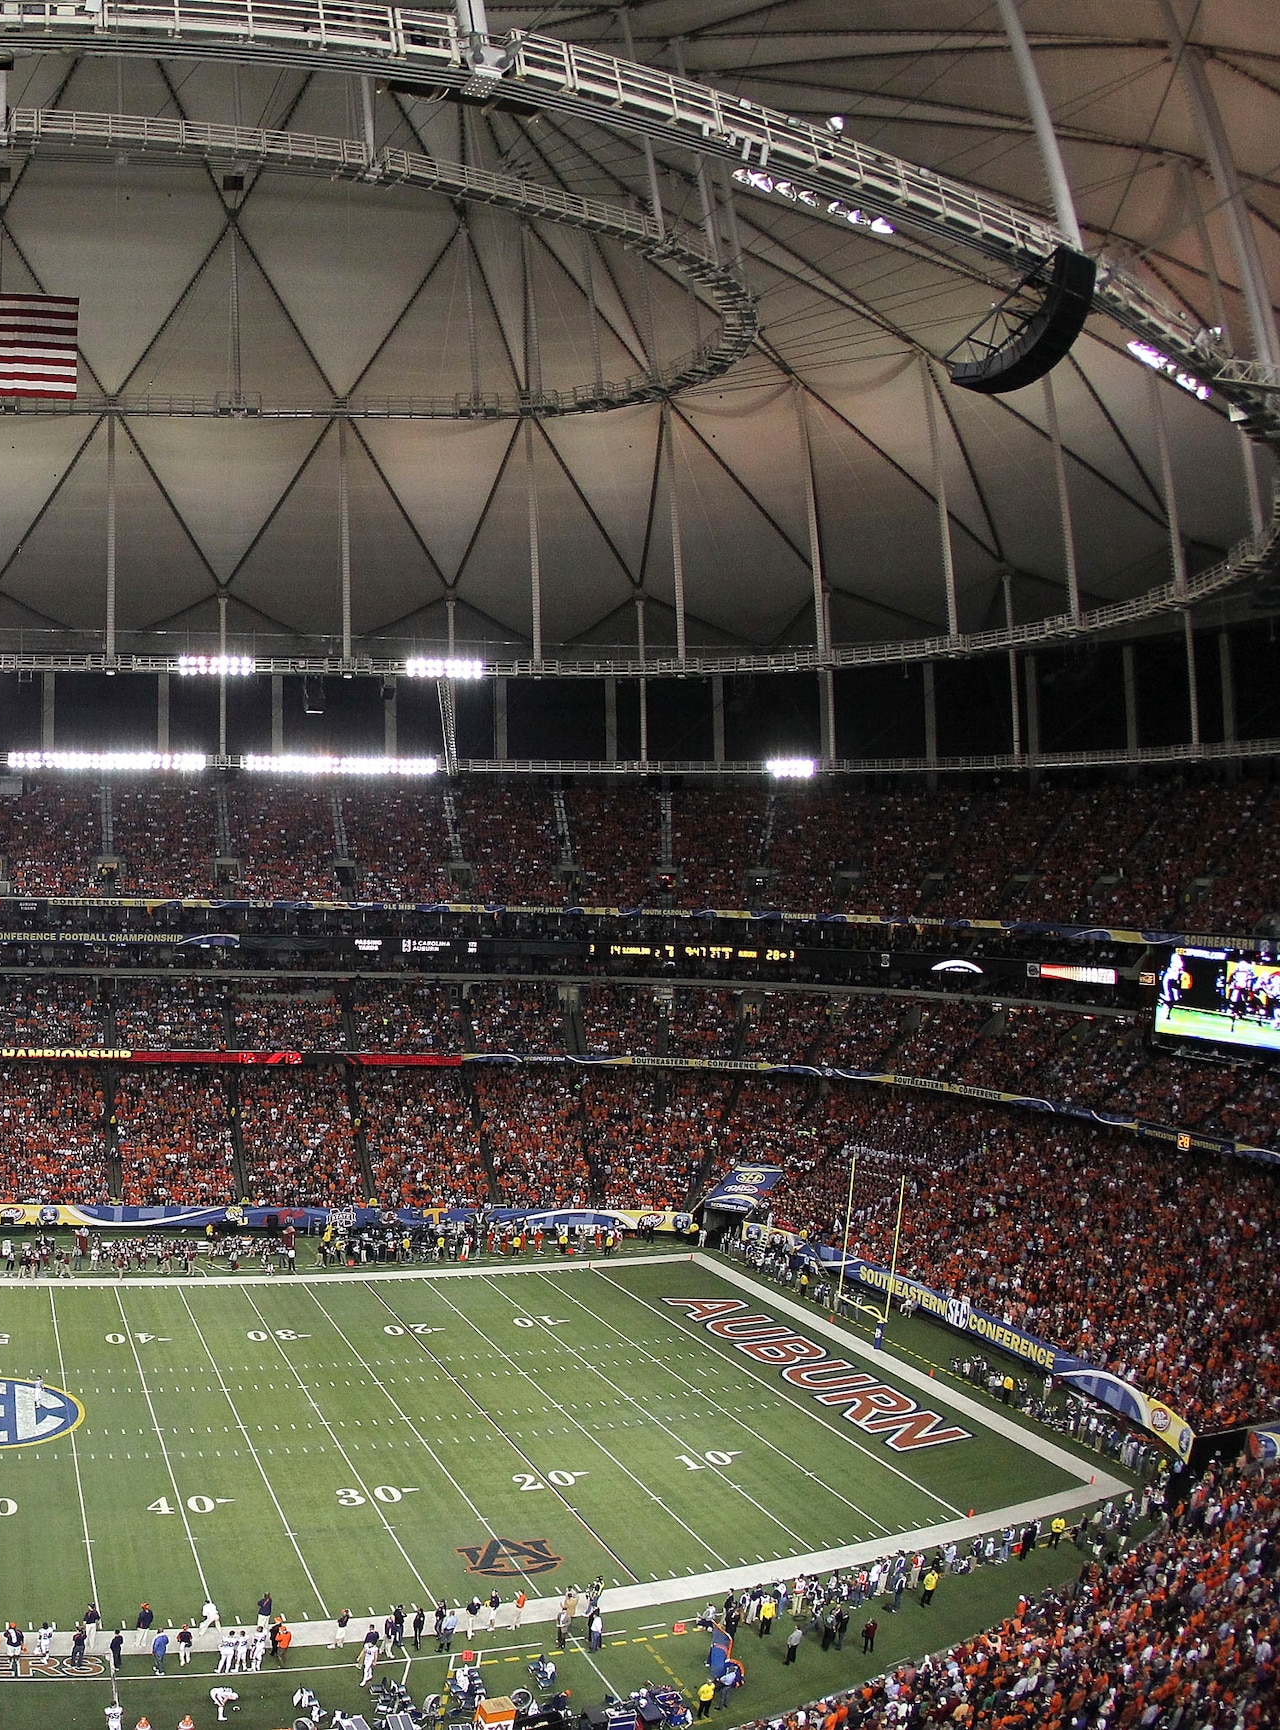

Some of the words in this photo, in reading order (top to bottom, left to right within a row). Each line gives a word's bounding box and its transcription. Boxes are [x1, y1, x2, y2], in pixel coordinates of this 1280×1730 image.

[59, 933, 107, 941] FOOTBALL
[109, 934, 184, 942] CHAMPIONSHIP
[1184, 934, 1255, 950] SOUTHEASTERN
[766, 949, 780, 960] 28
[631, 1057, 689, 1066] SOUTHEASTERN
[707, 1060, 758, 1069] CONFERENCE
[893, 1076, 944, 1091] SOUTHEASTERN
[959, 1086, 1002, 1100] CONFERENCE
[1178, 1135, 1190, 1148] 28
[739, 1172, 763, 1183] SEC
[710, 1202, 749, 1212] SECSPORTS.COM
[512, 1315, 559, 1328] 10
[859, 1265, 947, 1316] SOUTHEASTERN
[947, 1298, 969, 1329] SEC
[969, 1314, 1056, 1370] CONFERENCE
[246, 1329, 297, 1343] 30
[383, 1323, 433, 1336] 20
[104, 1332, 155, 1345] 40
[660, 1296, 974, 1453] AUBURN
[674, 1450, 733, 1471] 10
[511, 1470, 577, 1491] 20
[335, 1485, 403, 1507] 30
[146, 1495, 216, 1516] 40
